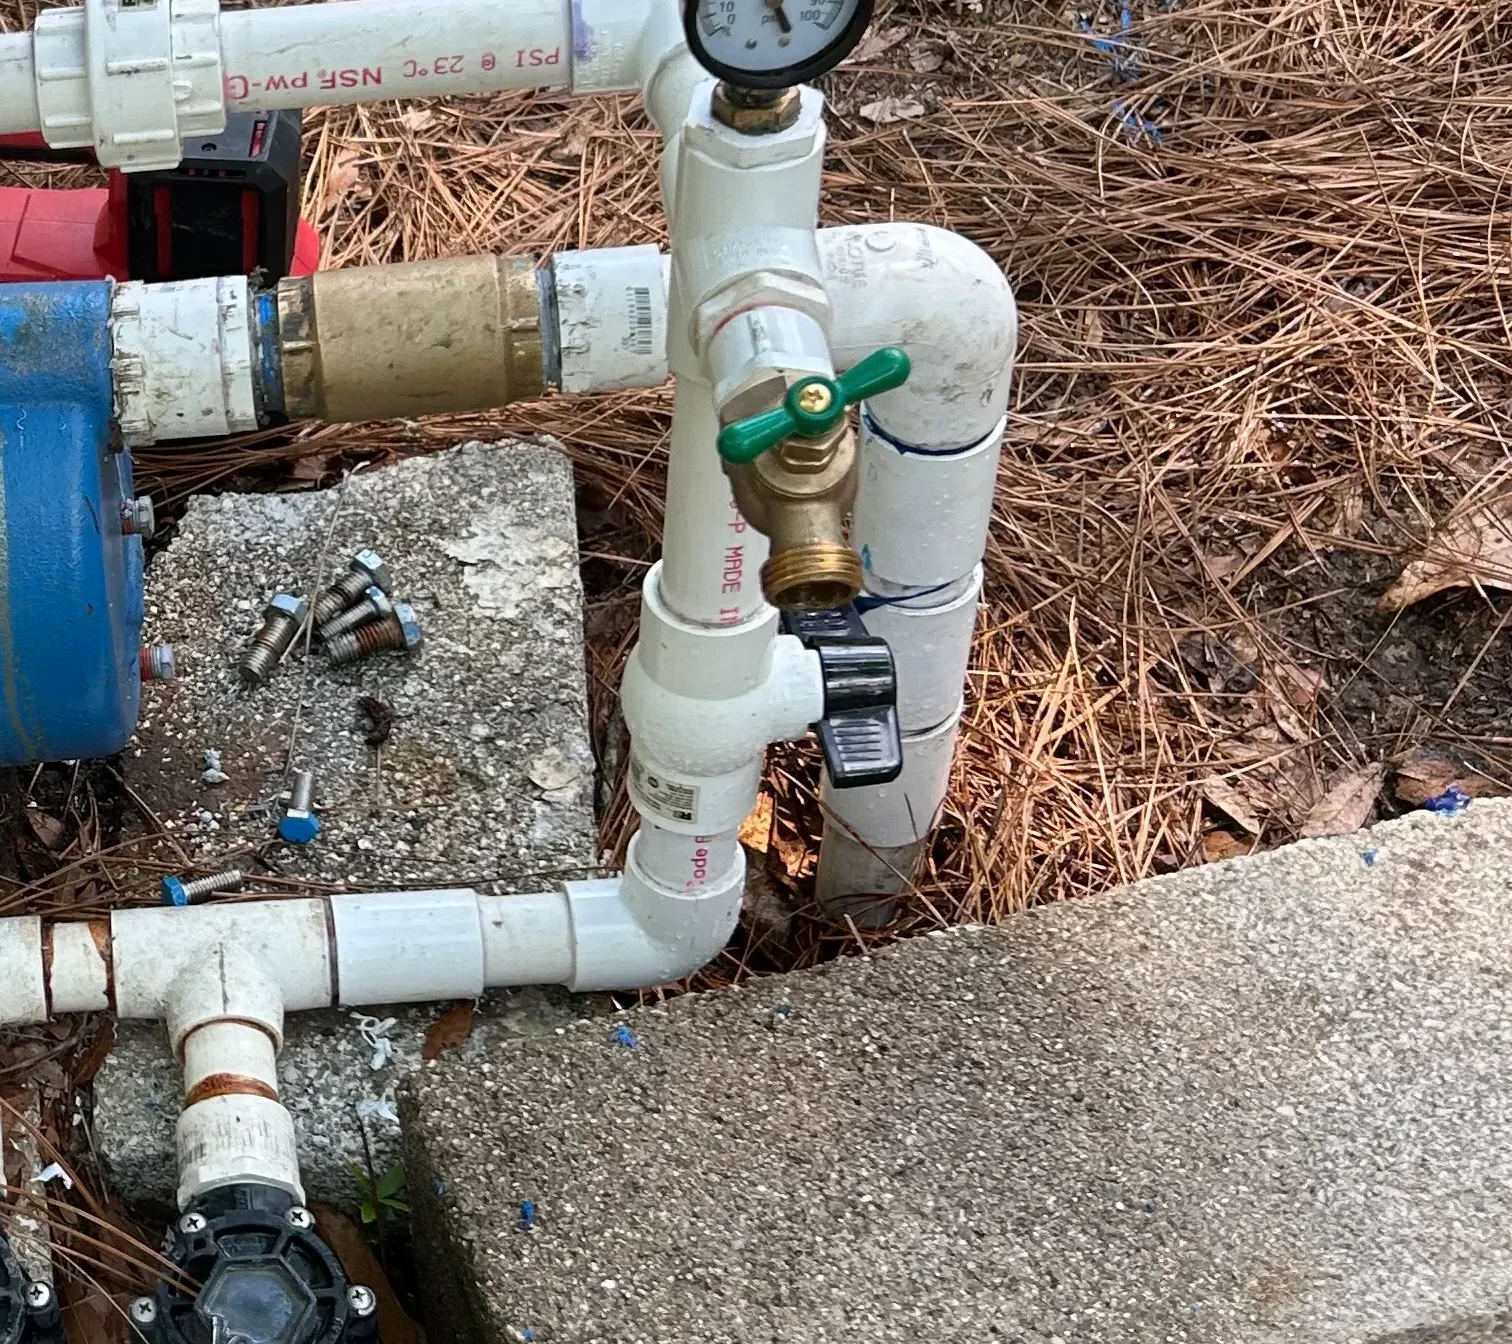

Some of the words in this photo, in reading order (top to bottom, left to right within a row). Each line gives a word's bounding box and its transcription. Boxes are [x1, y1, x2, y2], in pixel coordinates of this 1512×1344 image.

[719, 1, 734, 13] 10
[799, 9, 821, 22] 100
[727, 13, 736, 25] 0
[480, 51, 496, 71] @
[516, 46, 560, 67] PSI
[402, 55, 465, 79] 23°C
[721, 545, 744, 594] MADE
